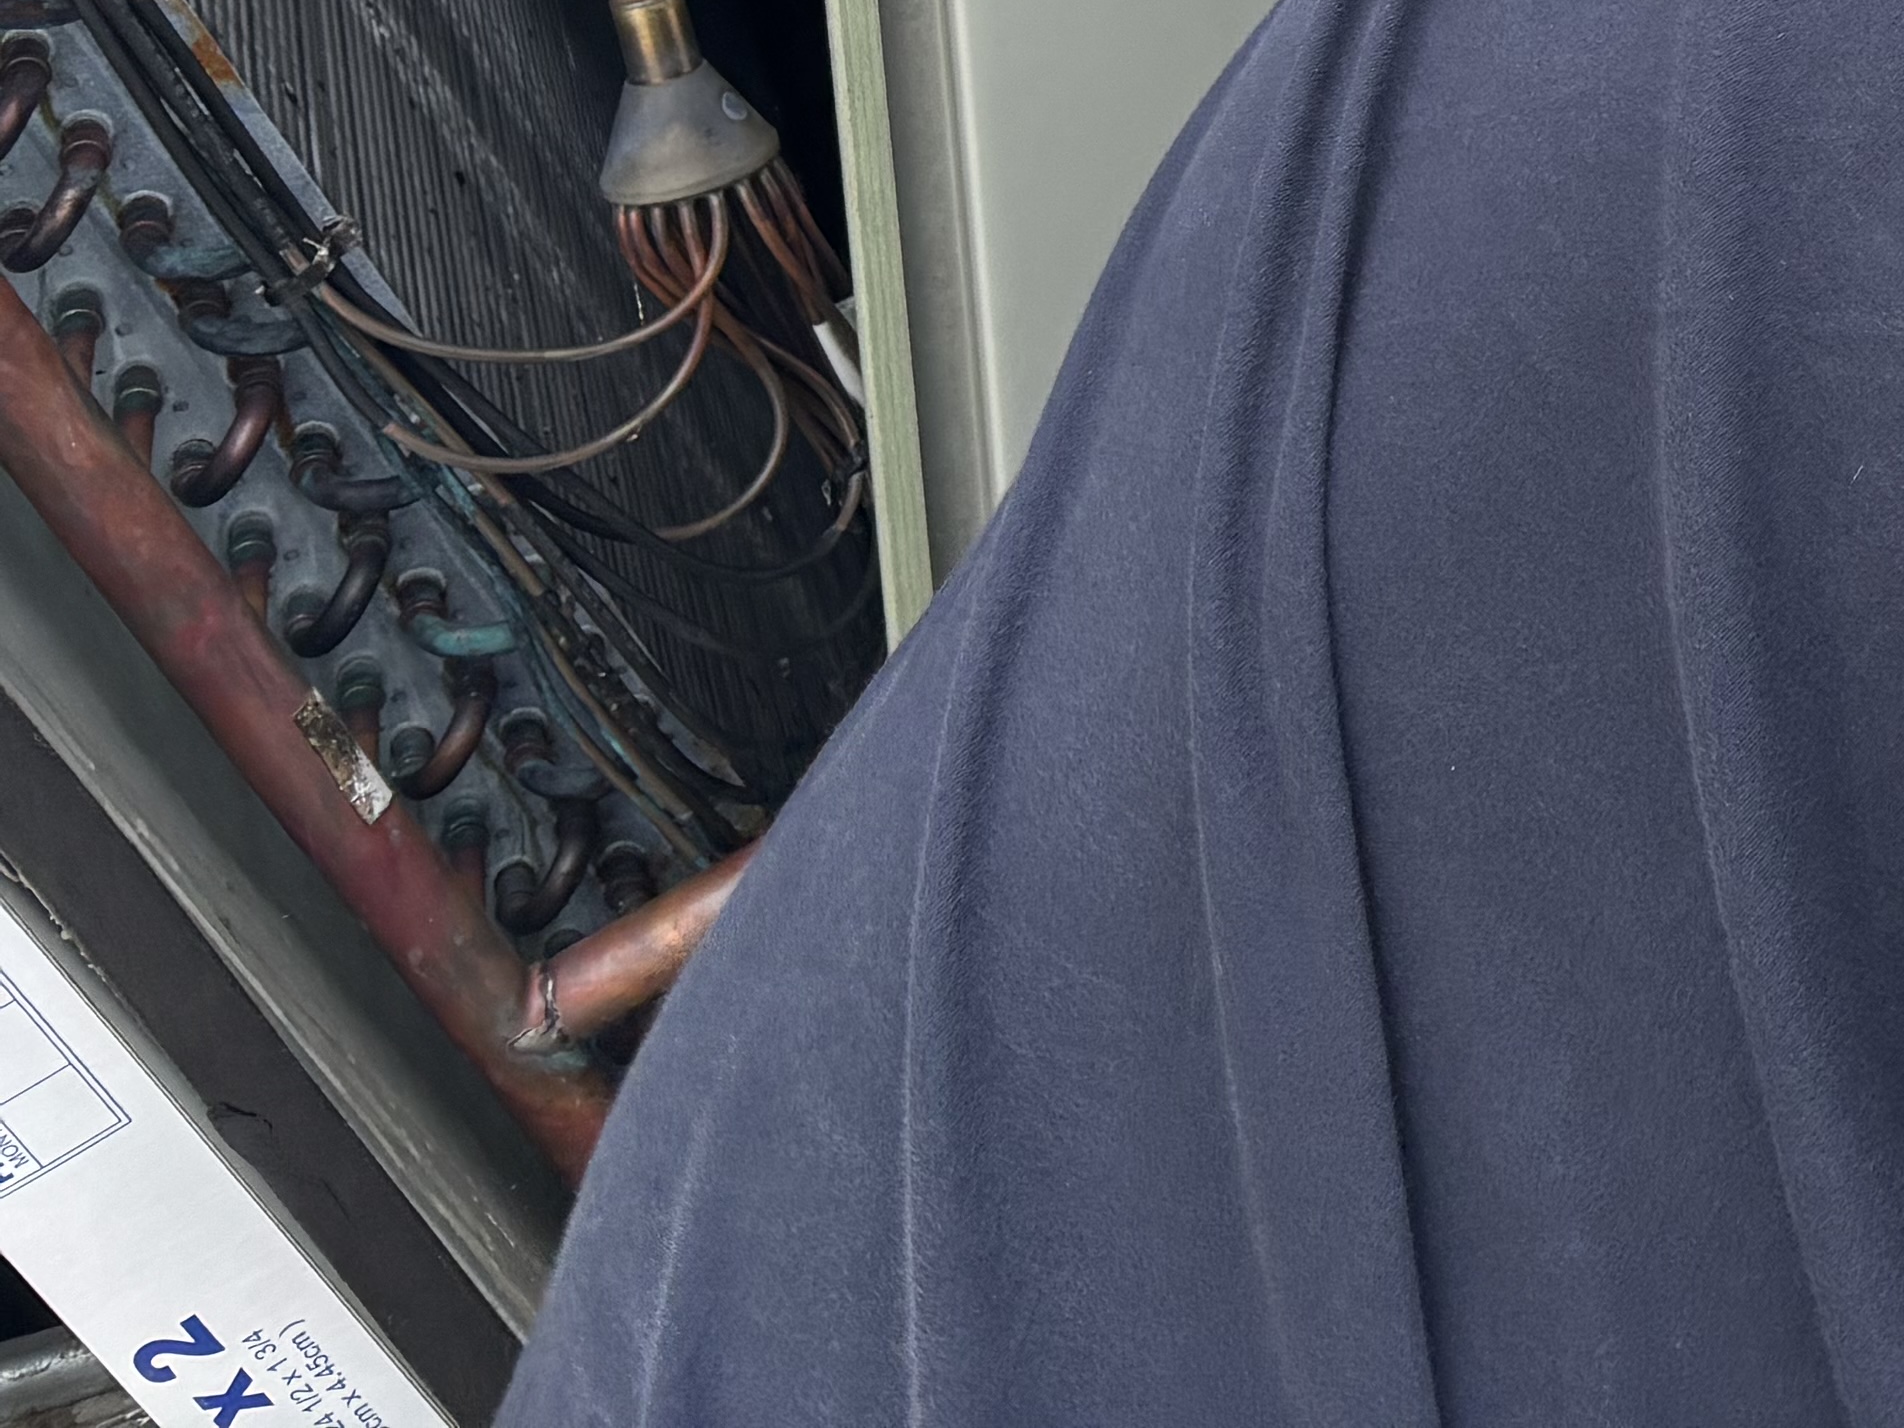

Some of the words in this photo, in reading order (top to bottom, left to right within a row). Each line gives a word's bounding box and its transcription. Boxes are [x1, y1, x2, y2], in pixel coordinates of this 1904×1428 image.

[0, 1129, 30, 1169] MON
[133, 1313, 226, 1383] 2
[241, 1328, 277, 1360] 3/4
[266, 1357, 287, 1372] 1
[292, 1331, 346, 1391] 4.45cm
[281, 1368, 302, 1386] x
[290, 1383, 322, 1412] 1/2
[341, 1389, 362, 1408] x
[354, 1402, 390, 1428] cm
